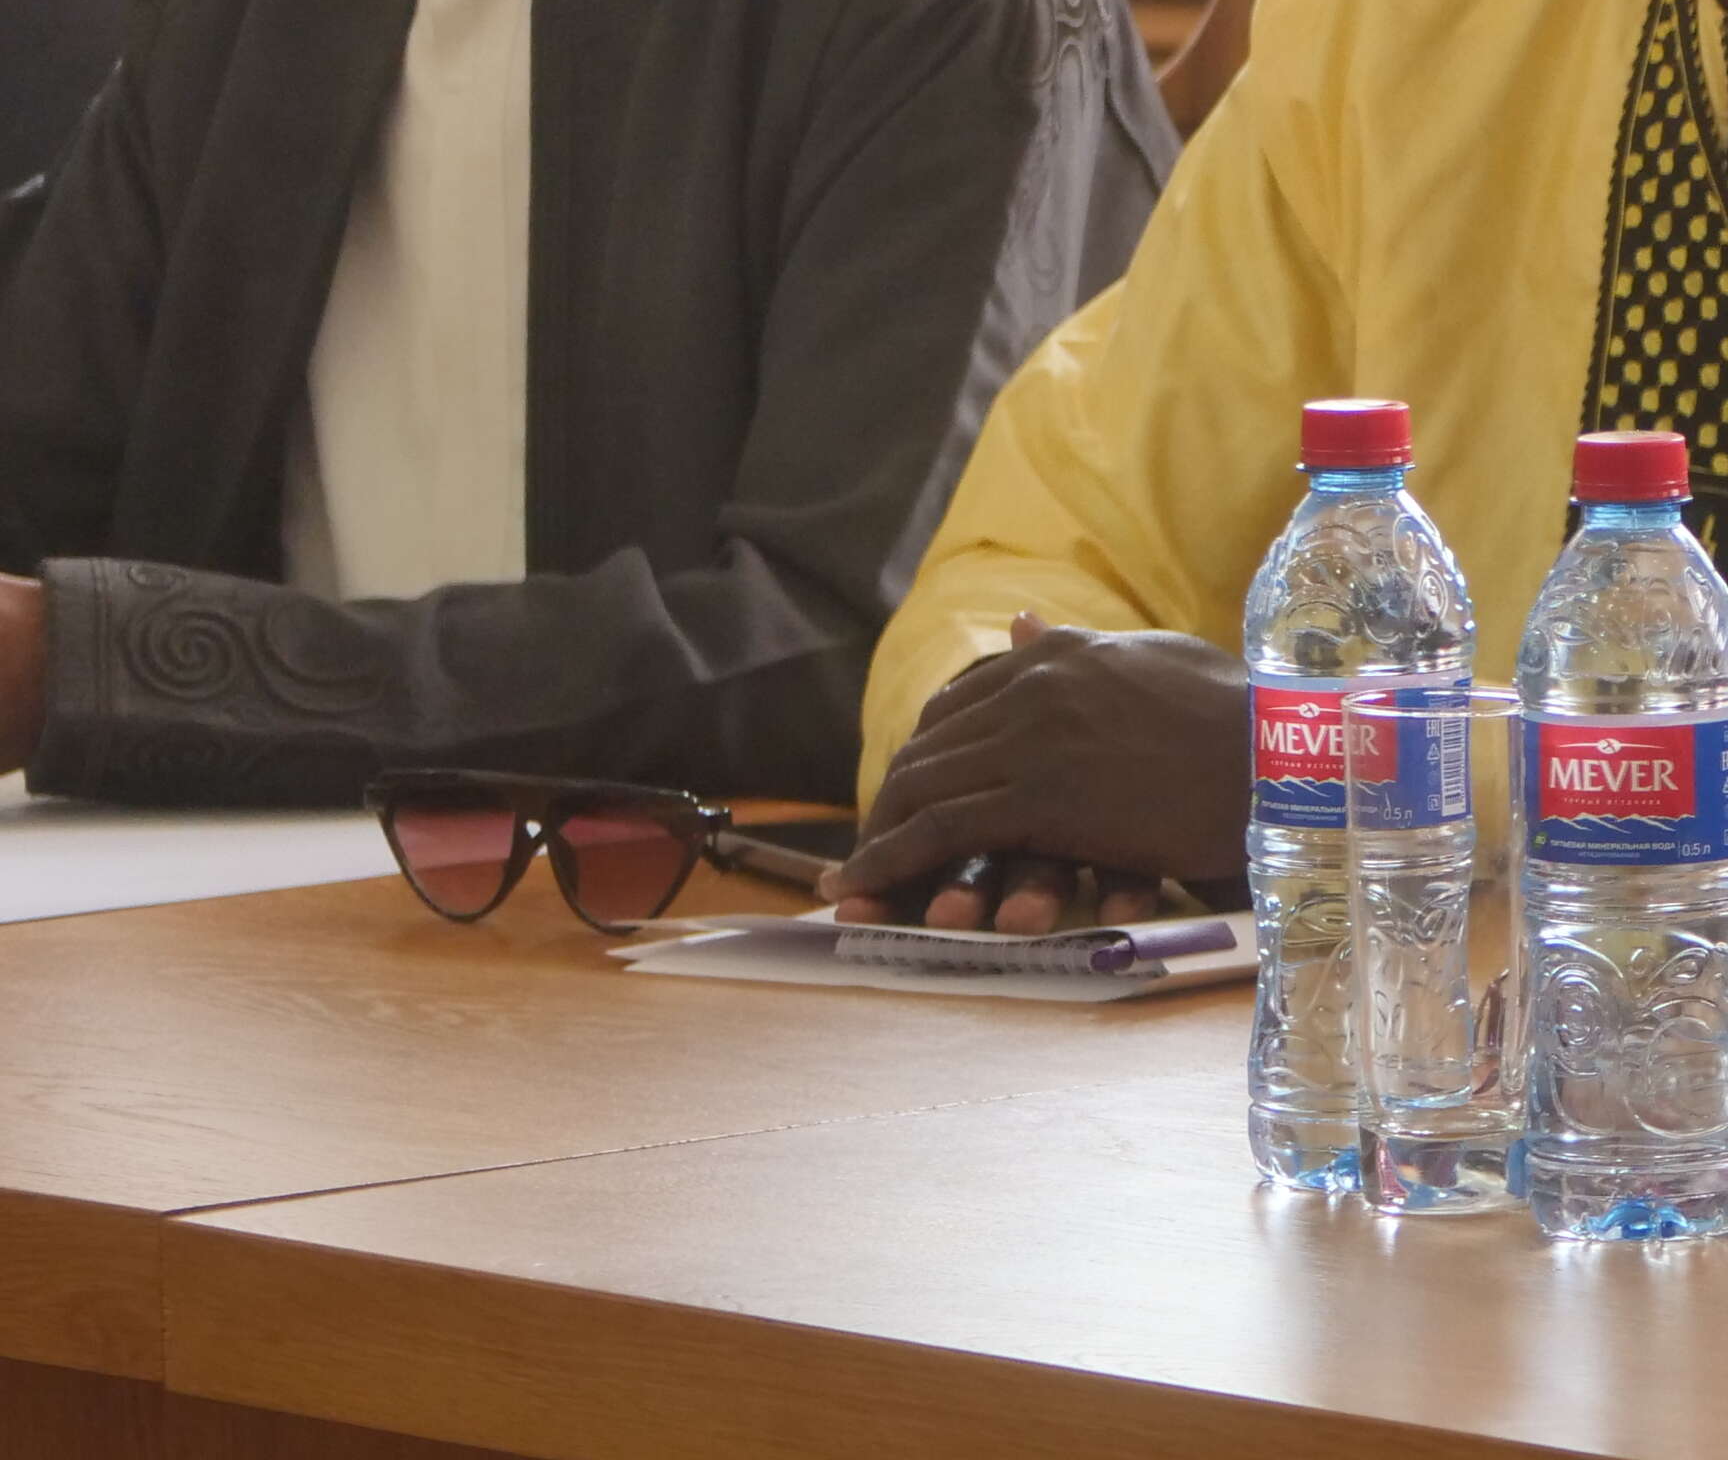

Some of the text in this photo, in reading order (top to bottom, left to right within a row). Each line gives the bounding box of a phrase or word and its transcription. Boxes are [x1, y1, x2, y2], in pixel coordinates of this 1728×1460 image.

[1259, 719, 1380, 757] MEVER
[1549, 757, 1679, 793] MEVER
[1652, 842, 1676, 851] ВОДА
